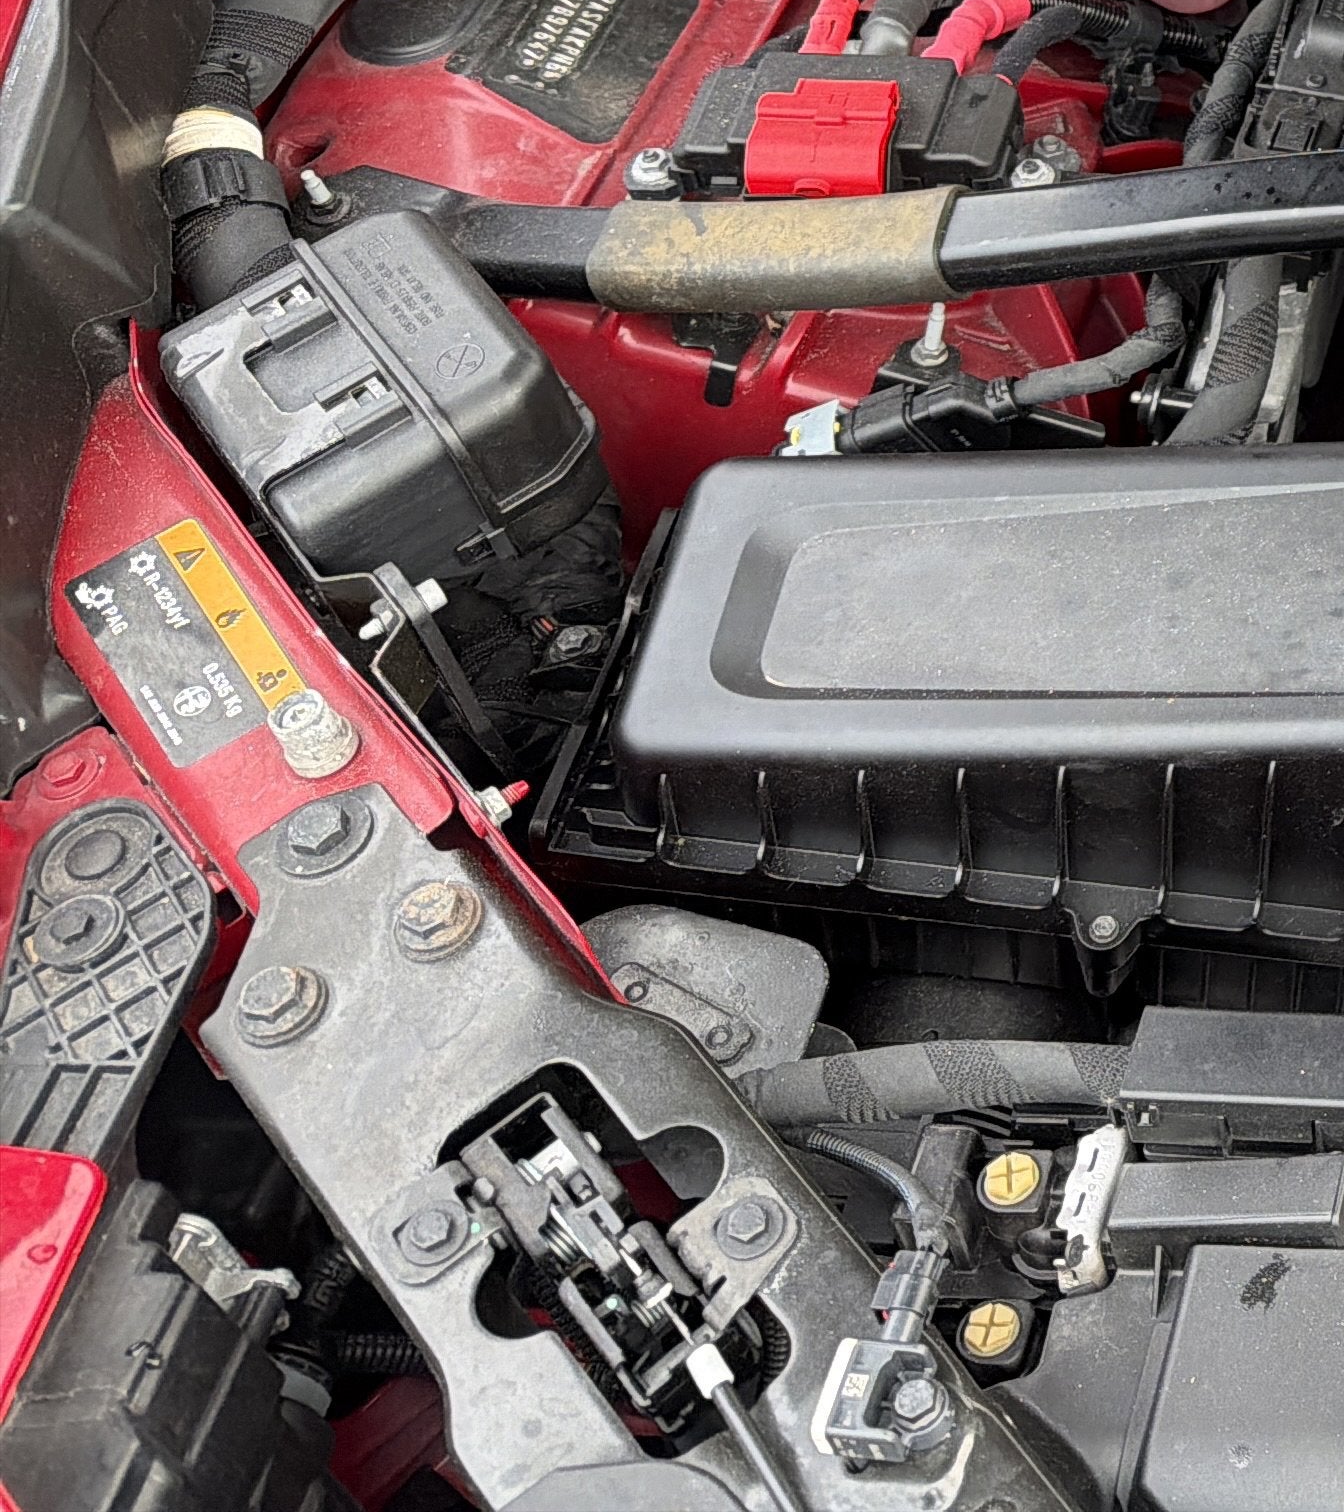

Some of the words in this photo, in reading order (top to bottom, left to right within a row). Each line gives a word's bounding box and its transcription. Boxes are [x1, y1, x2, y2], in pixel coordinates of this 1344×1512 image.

[101, 604, 129, 637] PAG
[143, 569, 191, 630] R-1234yf
[202, 662, 234, 698] 0.535
[223, 694, 243, 718] Kg
